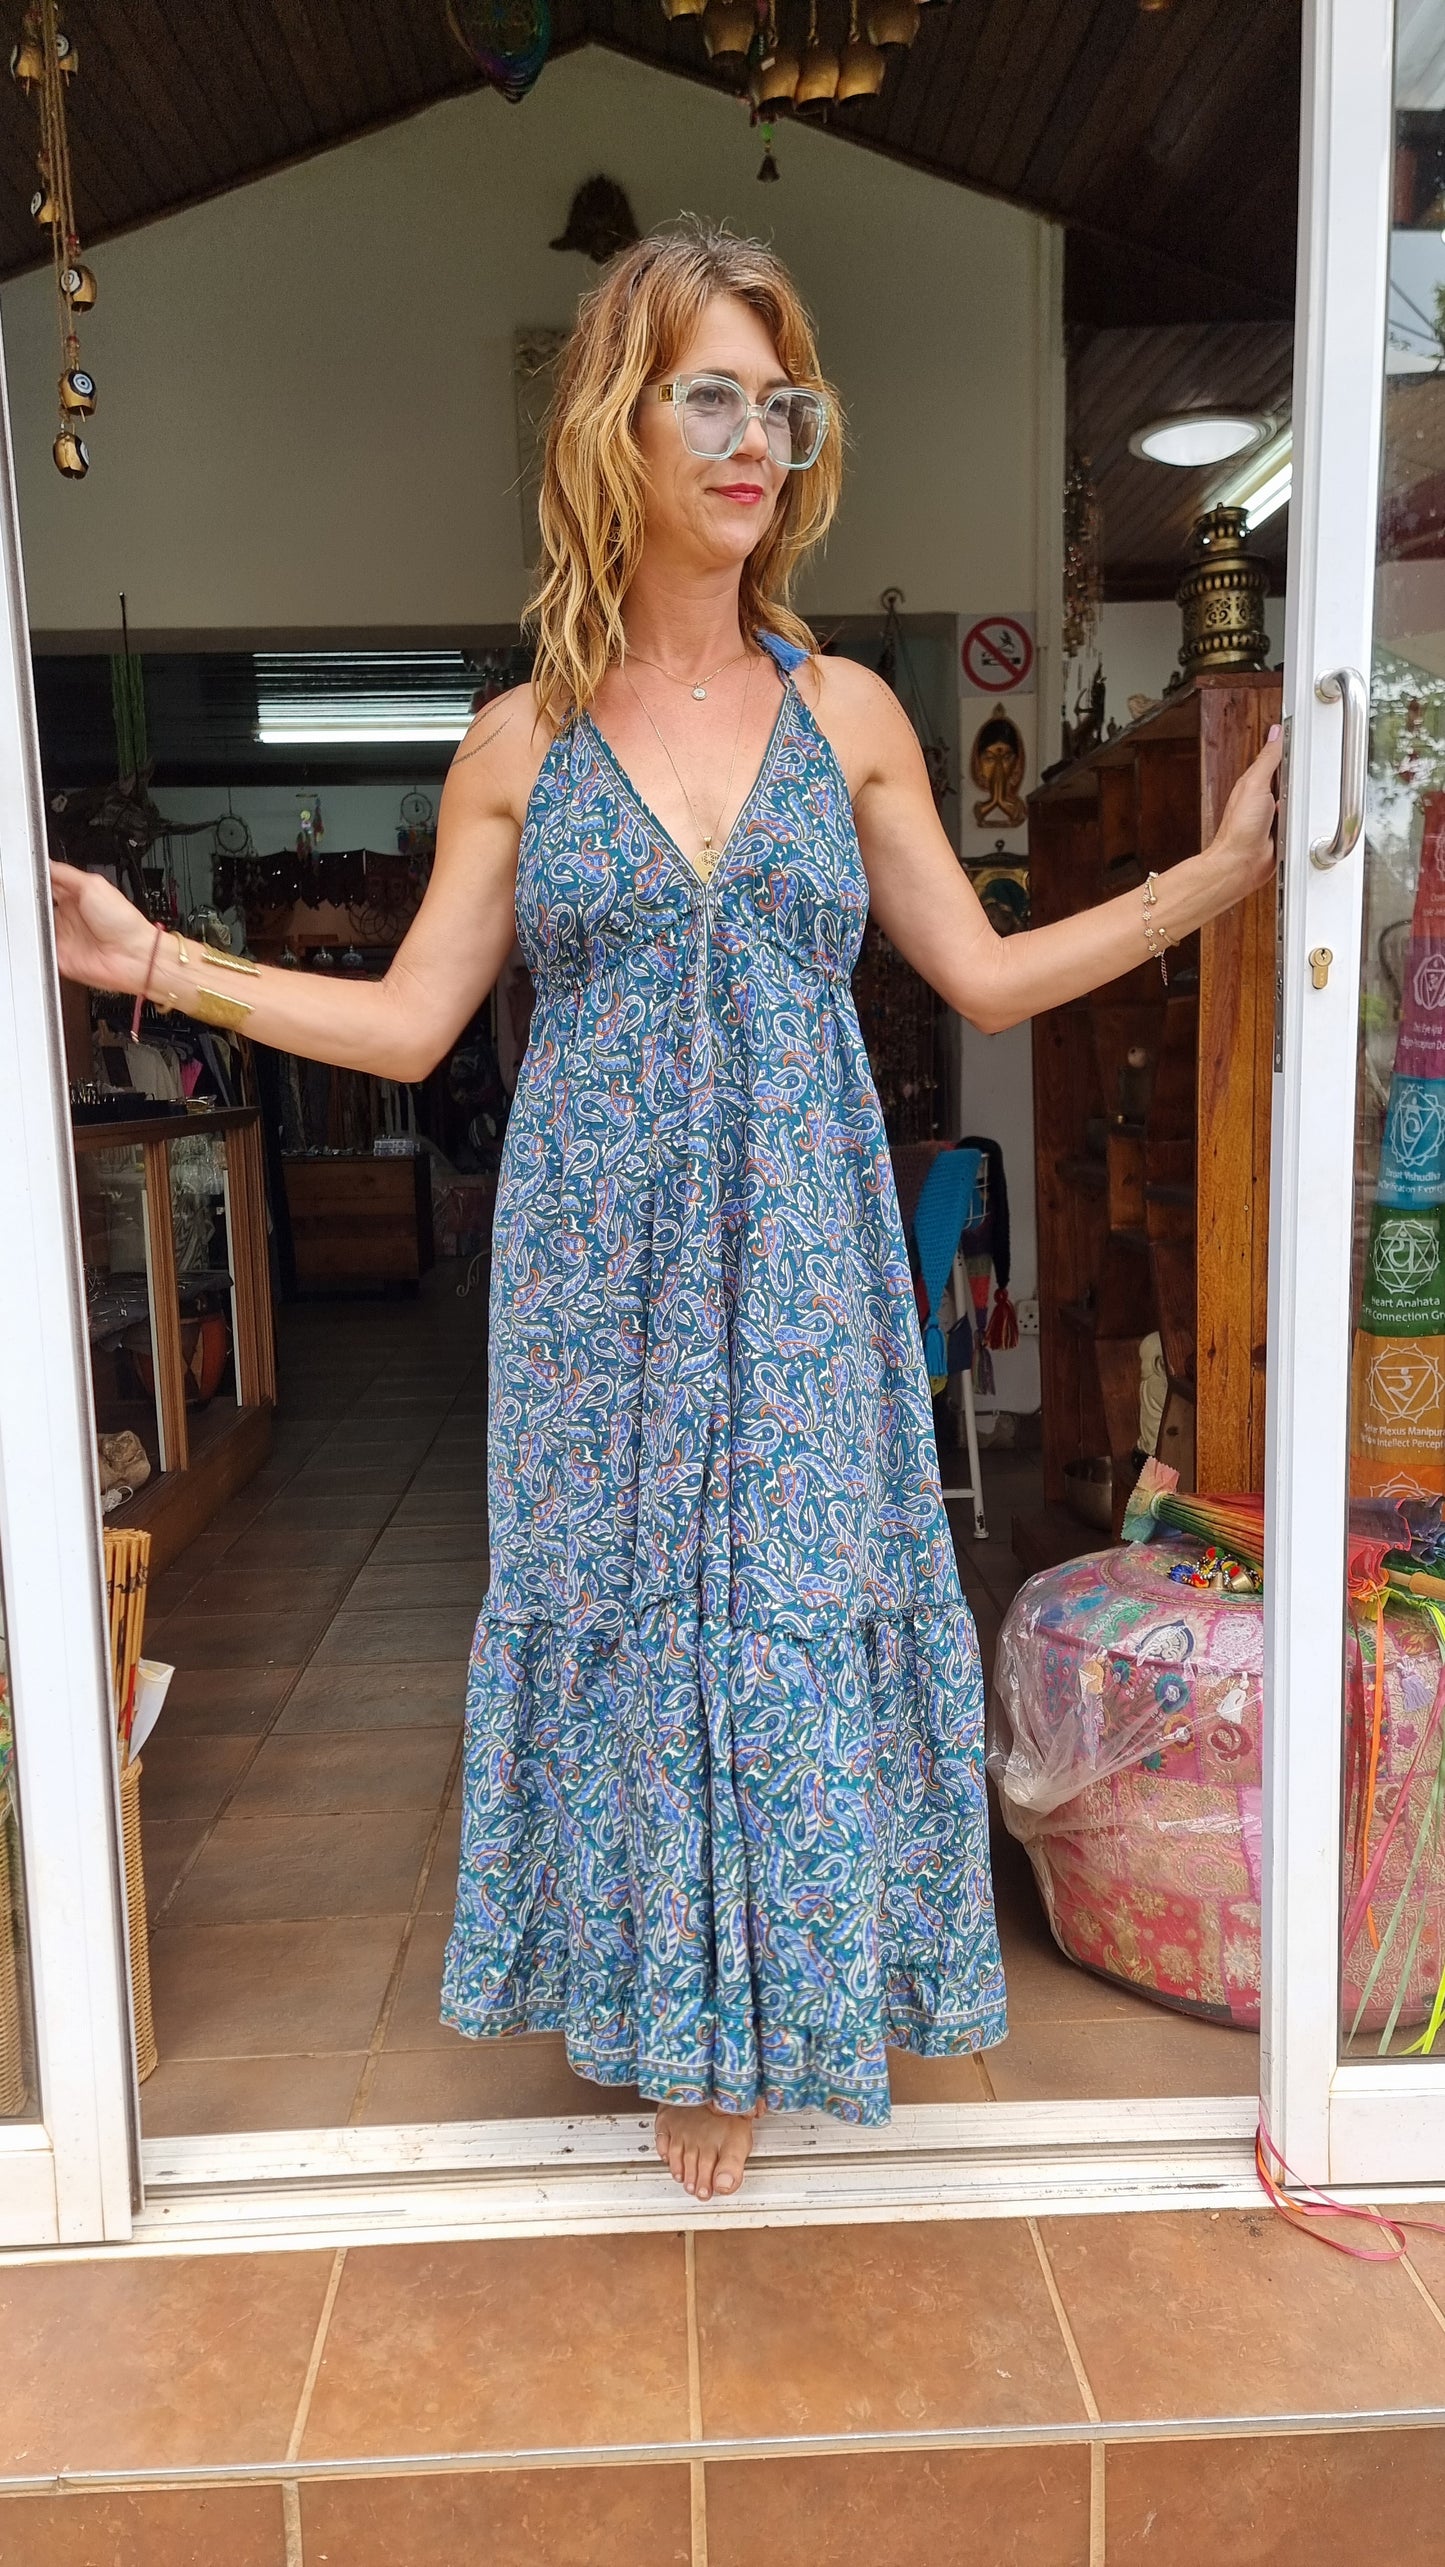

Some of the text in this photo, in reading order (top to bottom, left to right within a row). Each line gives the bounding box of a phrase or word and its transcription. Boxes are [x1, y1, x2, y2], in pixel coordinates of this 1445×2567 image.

[1395, 1297, 1441, 1308] Anahata
[1372, 1310, 1429, 1322] Connection
[1379, 1426, 1407, 1436] Plexus
[1377, 1437, 1410, 1448] Intellect
